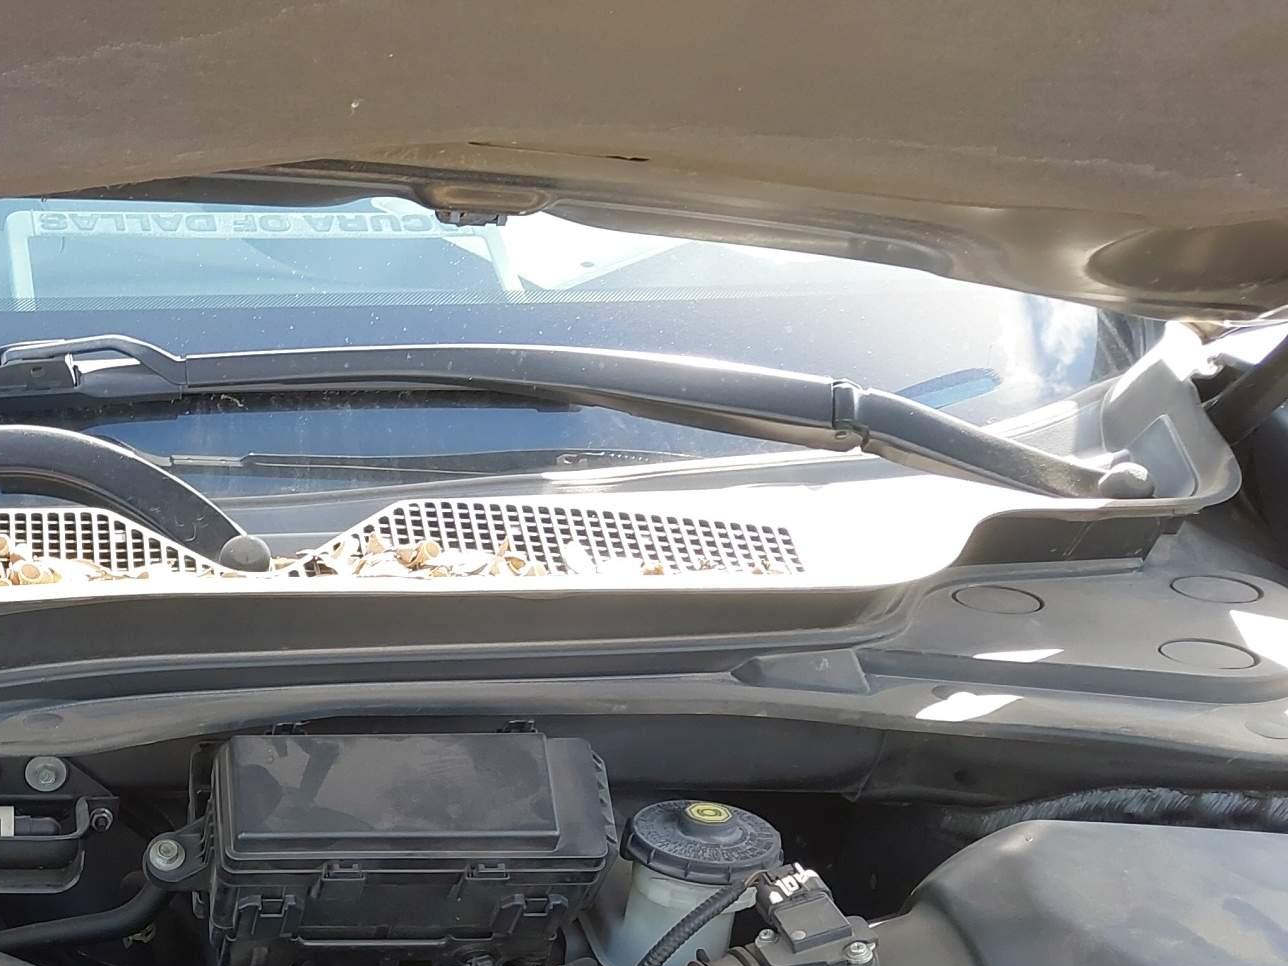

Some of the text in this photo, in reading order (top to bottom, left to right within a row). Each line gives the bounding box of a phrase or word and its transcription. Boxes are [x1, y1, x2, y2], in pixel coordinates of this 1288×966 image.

[39, 212, 459, 233] CURA OF DALLAS
